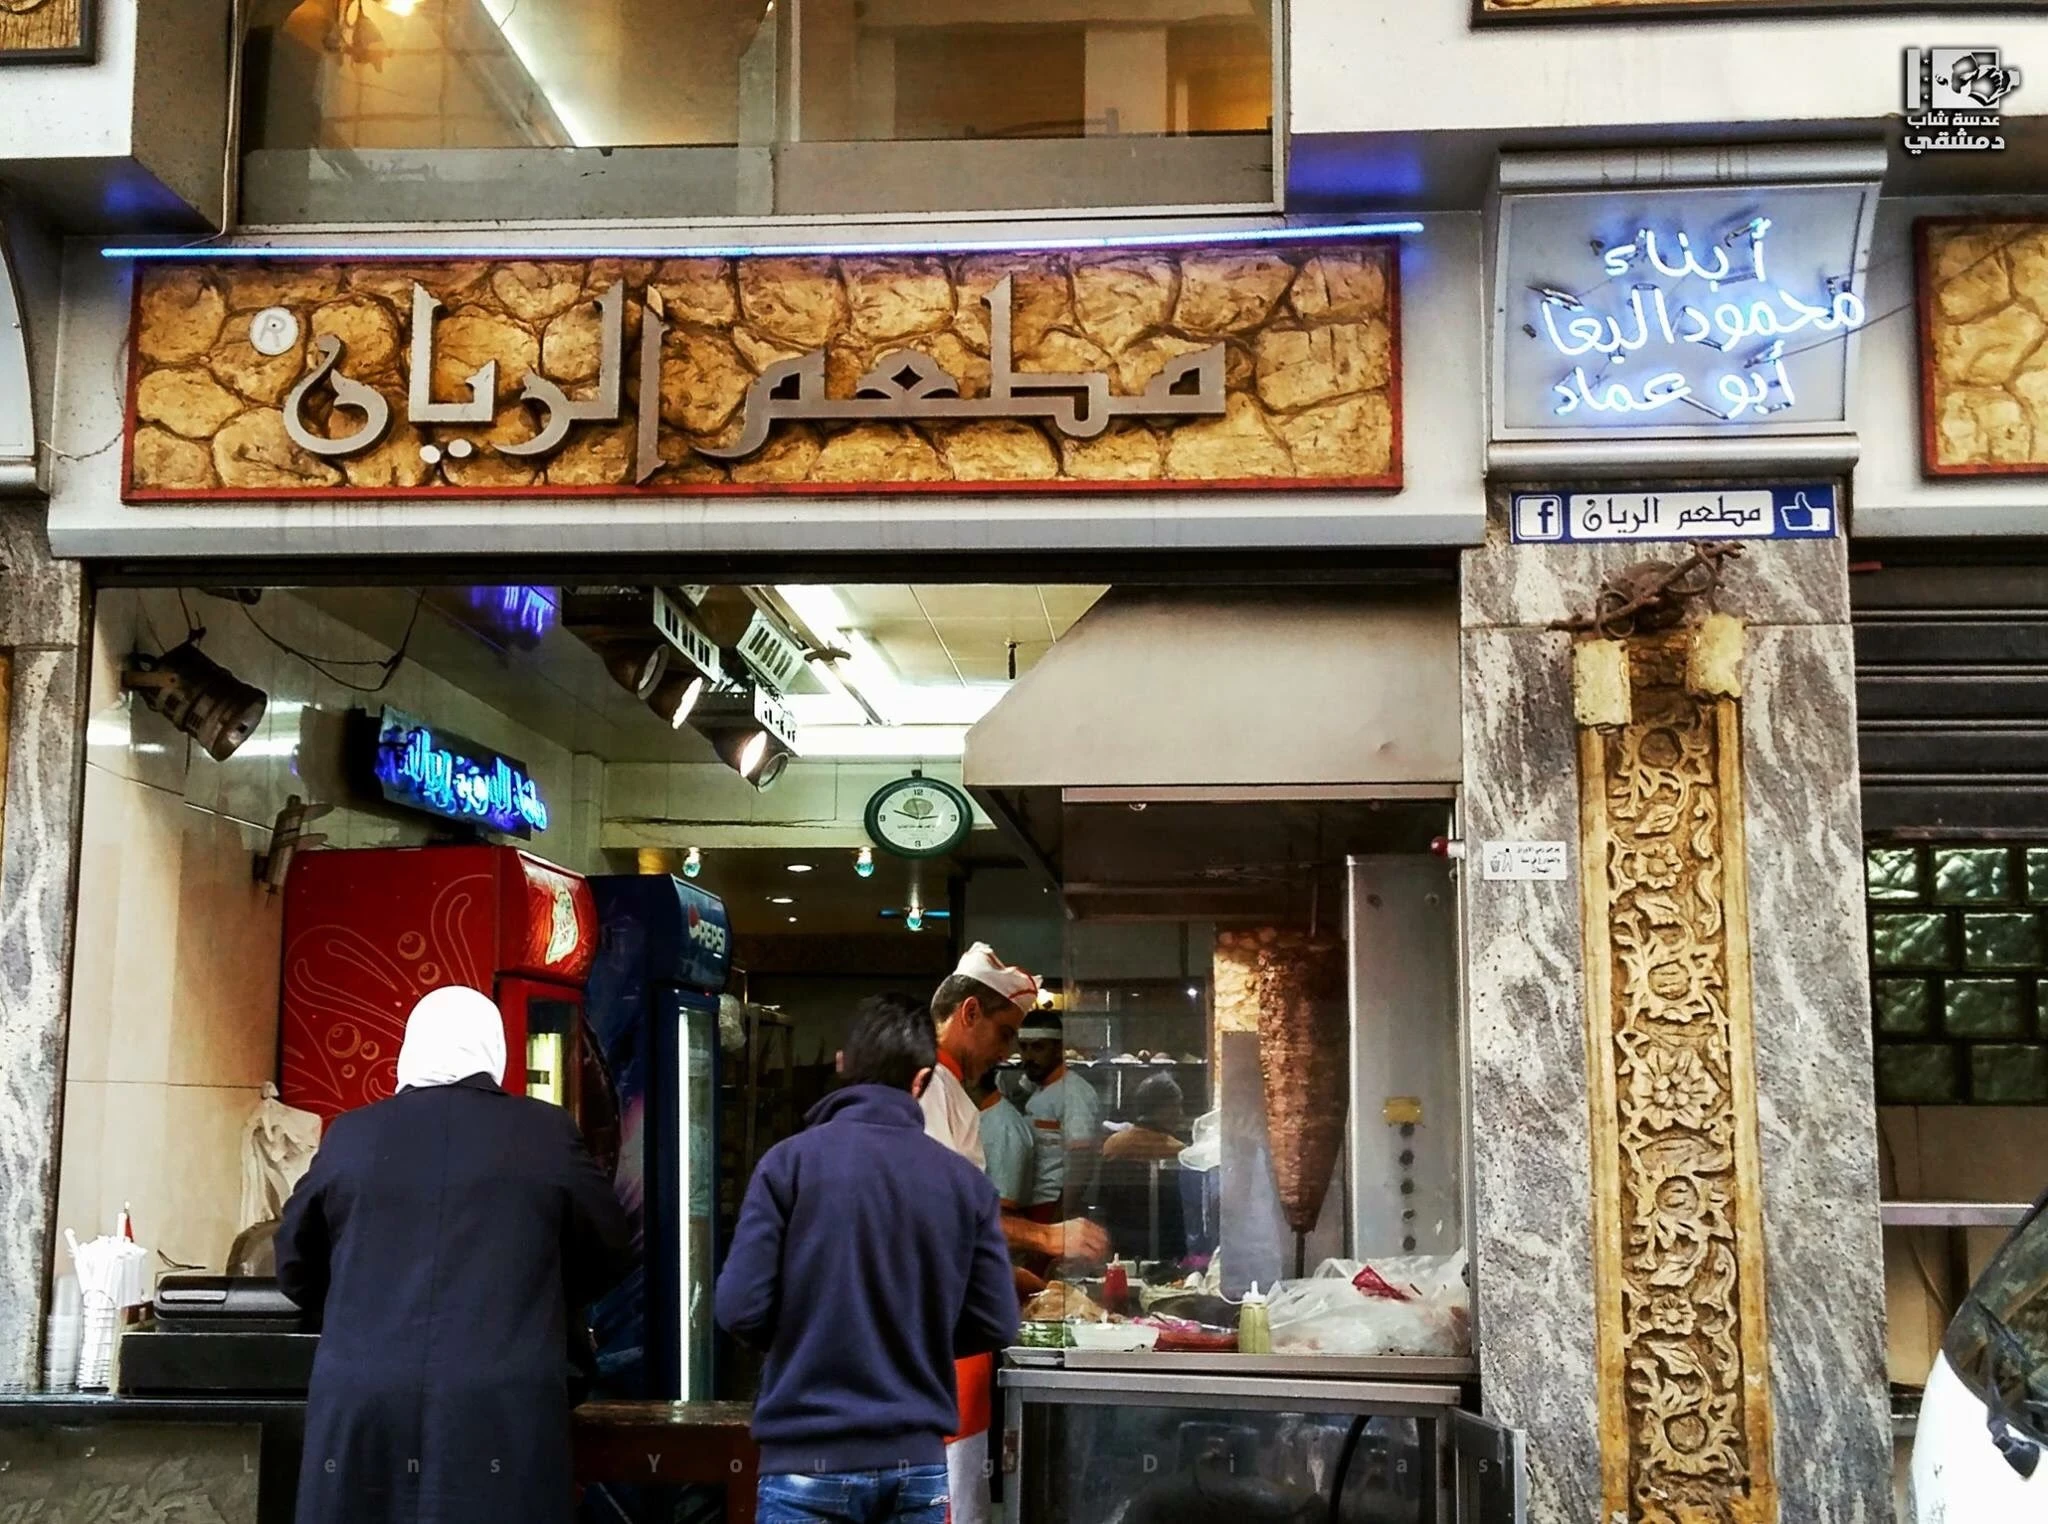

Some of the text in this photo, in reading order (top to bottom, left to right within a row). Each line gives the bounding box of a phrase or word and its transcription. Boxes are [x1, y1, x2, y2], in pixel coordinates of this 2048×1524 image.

[1605, 217, 1772, 292] أبناء
[282, 271, 1227, 487] مطعم الريان
[1554, 340, 1795, 420] أبو عماد
[1582, 495, 1761, 534] مطعم الريان
[698, 919, 726, 955] PEPSI
